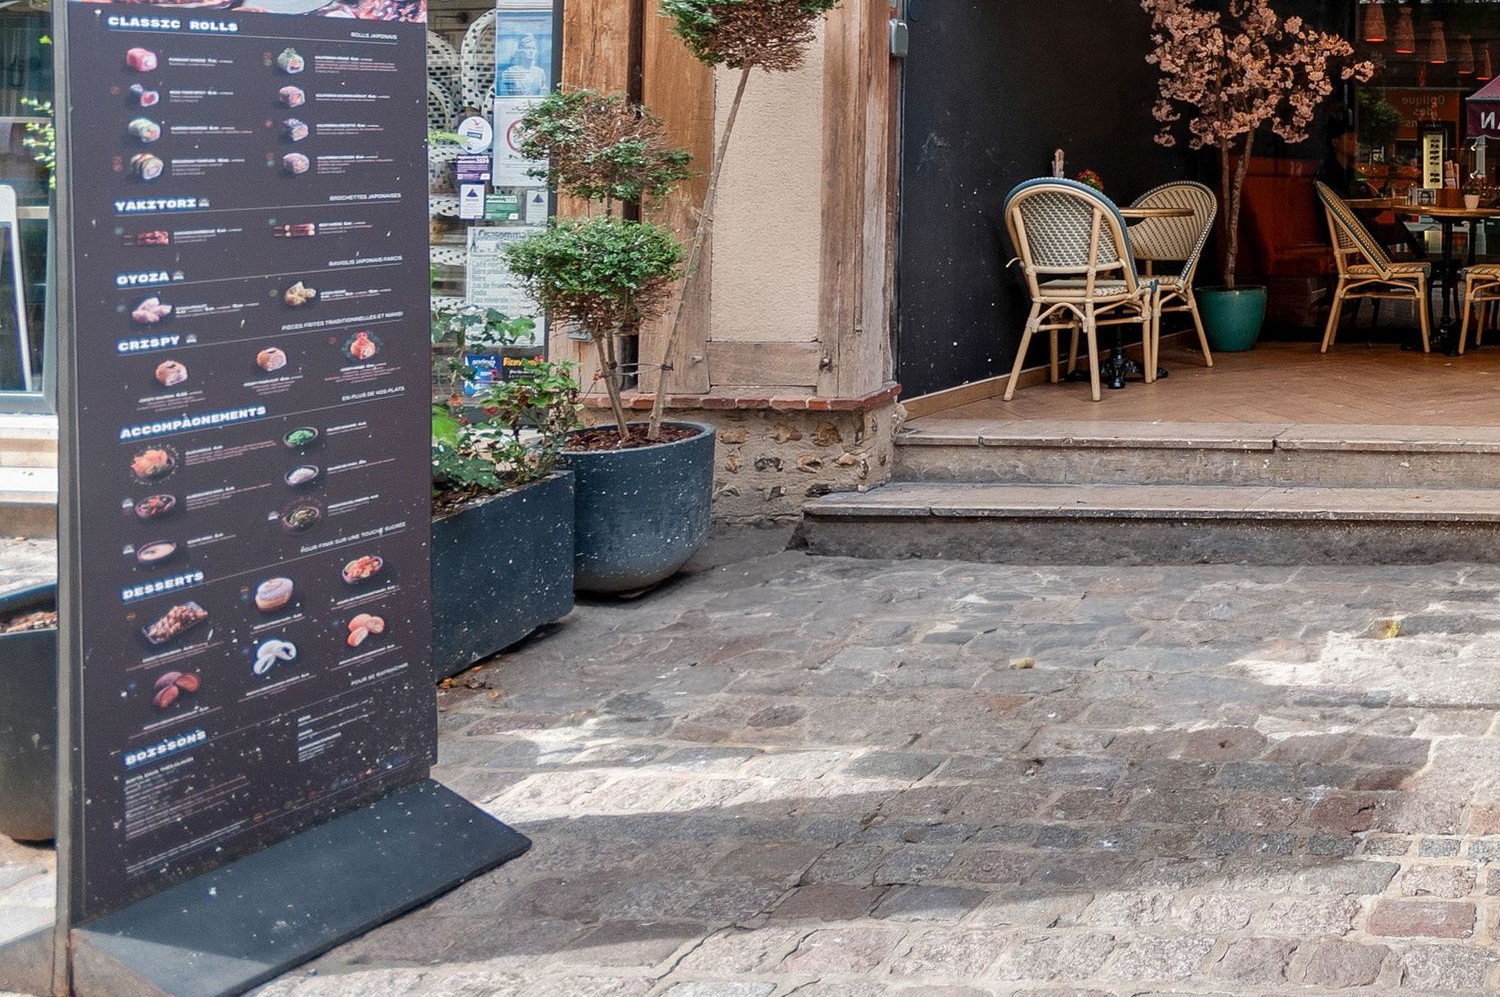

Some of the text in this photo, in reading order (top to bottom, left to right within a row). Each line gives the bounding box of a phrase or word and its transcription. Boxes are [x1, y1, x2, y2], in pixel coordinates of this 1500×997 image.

[107, 16, 239, 32] CLASSIC ROLLS
[114, 198, 197, 212] YAKITORI
[118, 335, 180, 352] CRISPY
[121, 571, 205, 602] DESSERTS
[125, 730, 207, 766] BOISSONS
